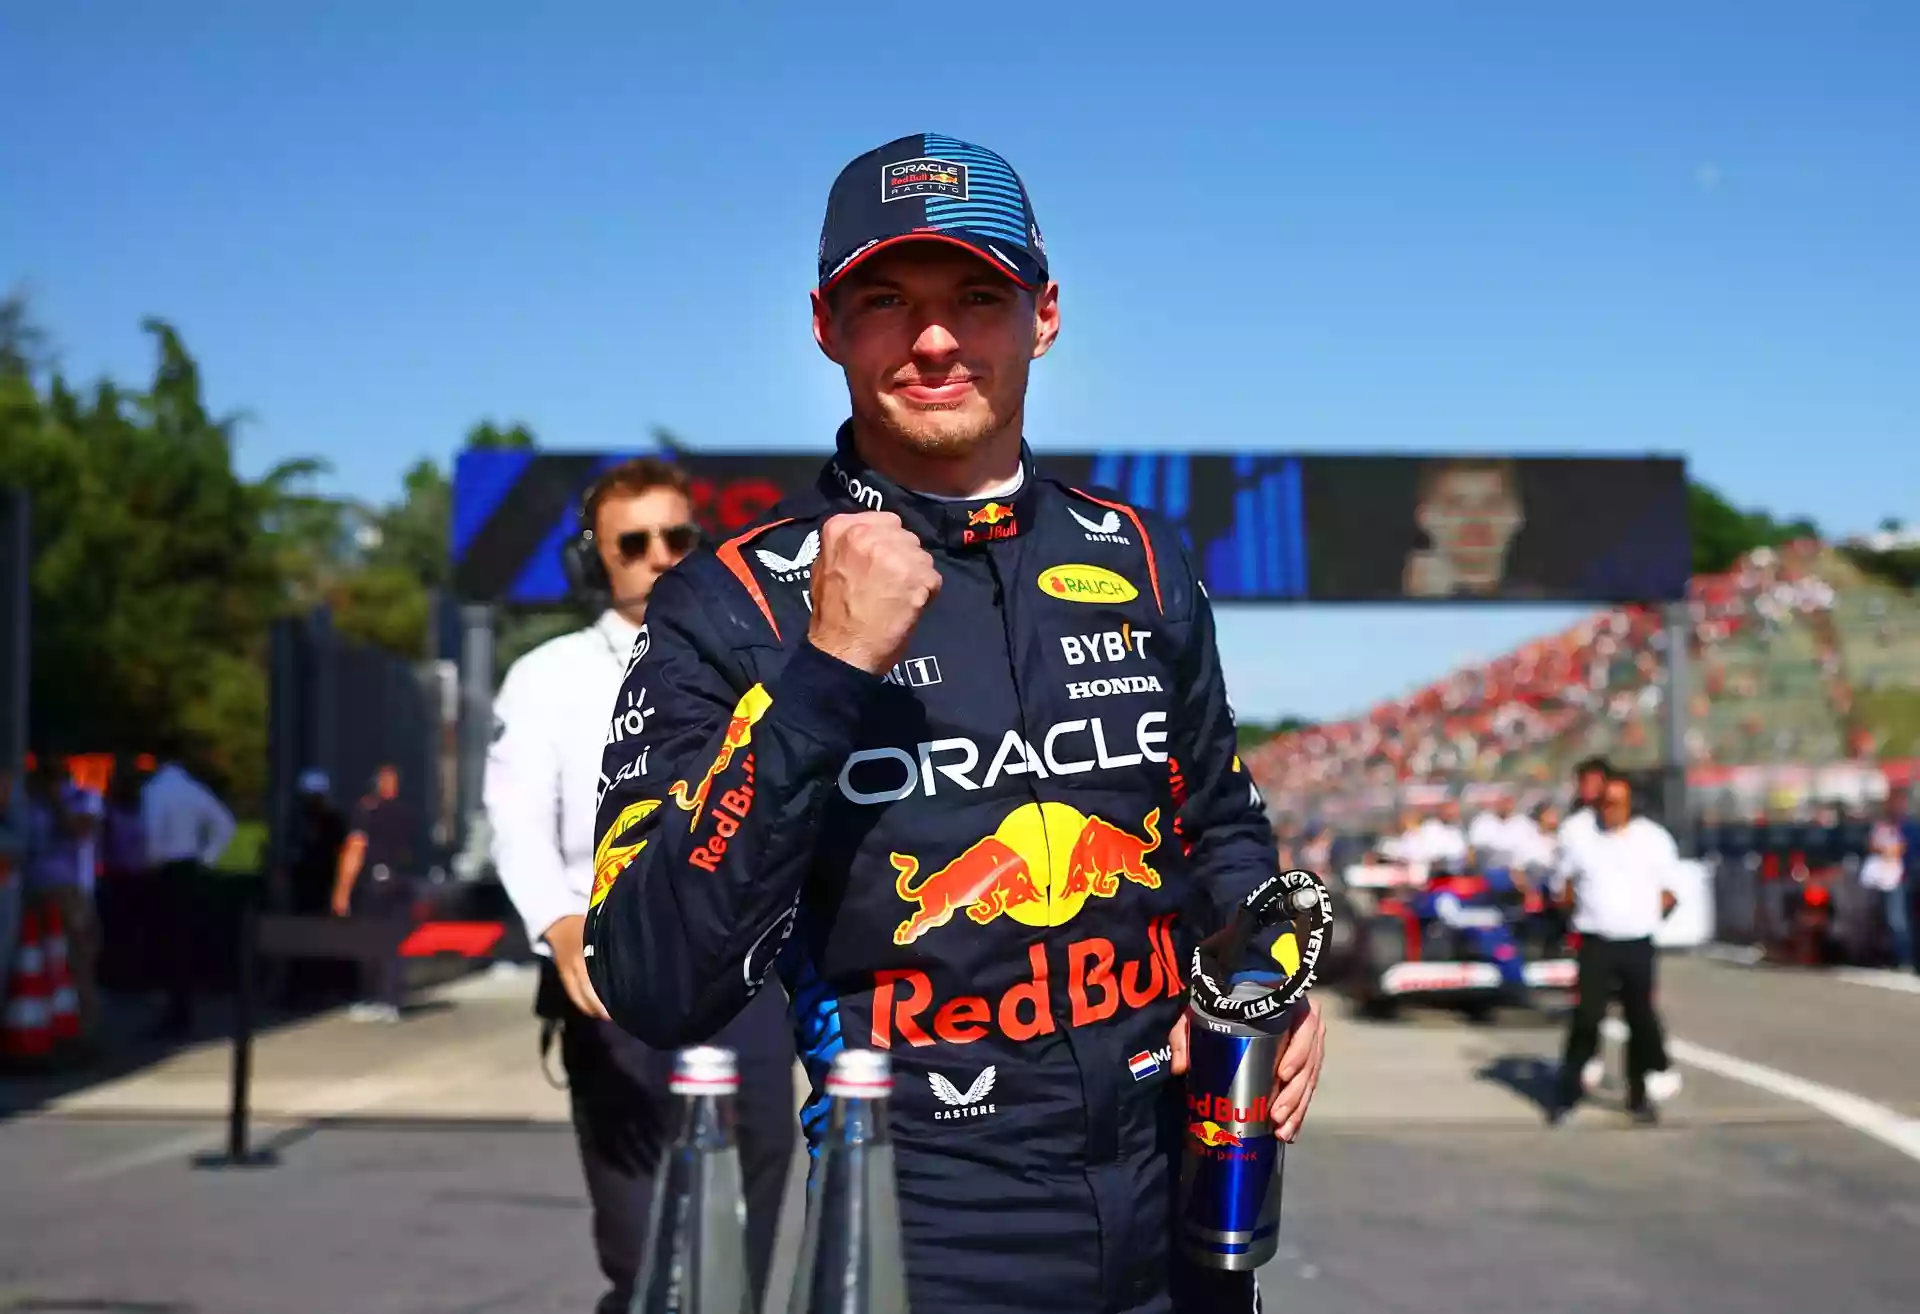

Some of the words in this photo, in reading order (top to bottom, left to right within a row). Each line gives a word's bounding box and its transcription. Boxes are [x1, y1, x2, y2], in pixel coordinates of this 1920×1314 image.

[892, 163, 958, 176] ORACLE
[891, 184, 959, 195] RACING
[1084, 532, 1131, 546] CASTORE
[769, 569, 811, 583] ASTO
[1063, 576, 1127, 597] RAUCH
[1060, 622, 1152, 666] BYBIT
[1065, 675, 1164, 701] HONDA
[838, 711, 1169, 805] ORACLE
[688, 808, 742, 873] Red
[1280, 870, 1314, 889] YETI
[1314, 883, 1334, 925] YETI
[1302, 927, 1325, 970] YETI
[871, 942, 1056, 1050] Red
[1068, 913, 1187, 1028] Bull
[1213, 995, 1243, 1011] YETI
[1244, 995, 1281, 1020] YETI
[1208, 1019, 1232, 1034] YETI
[934, 1103, 996, 1120] CASTORE
[1213, 1095, 1267, 1123] Bull
